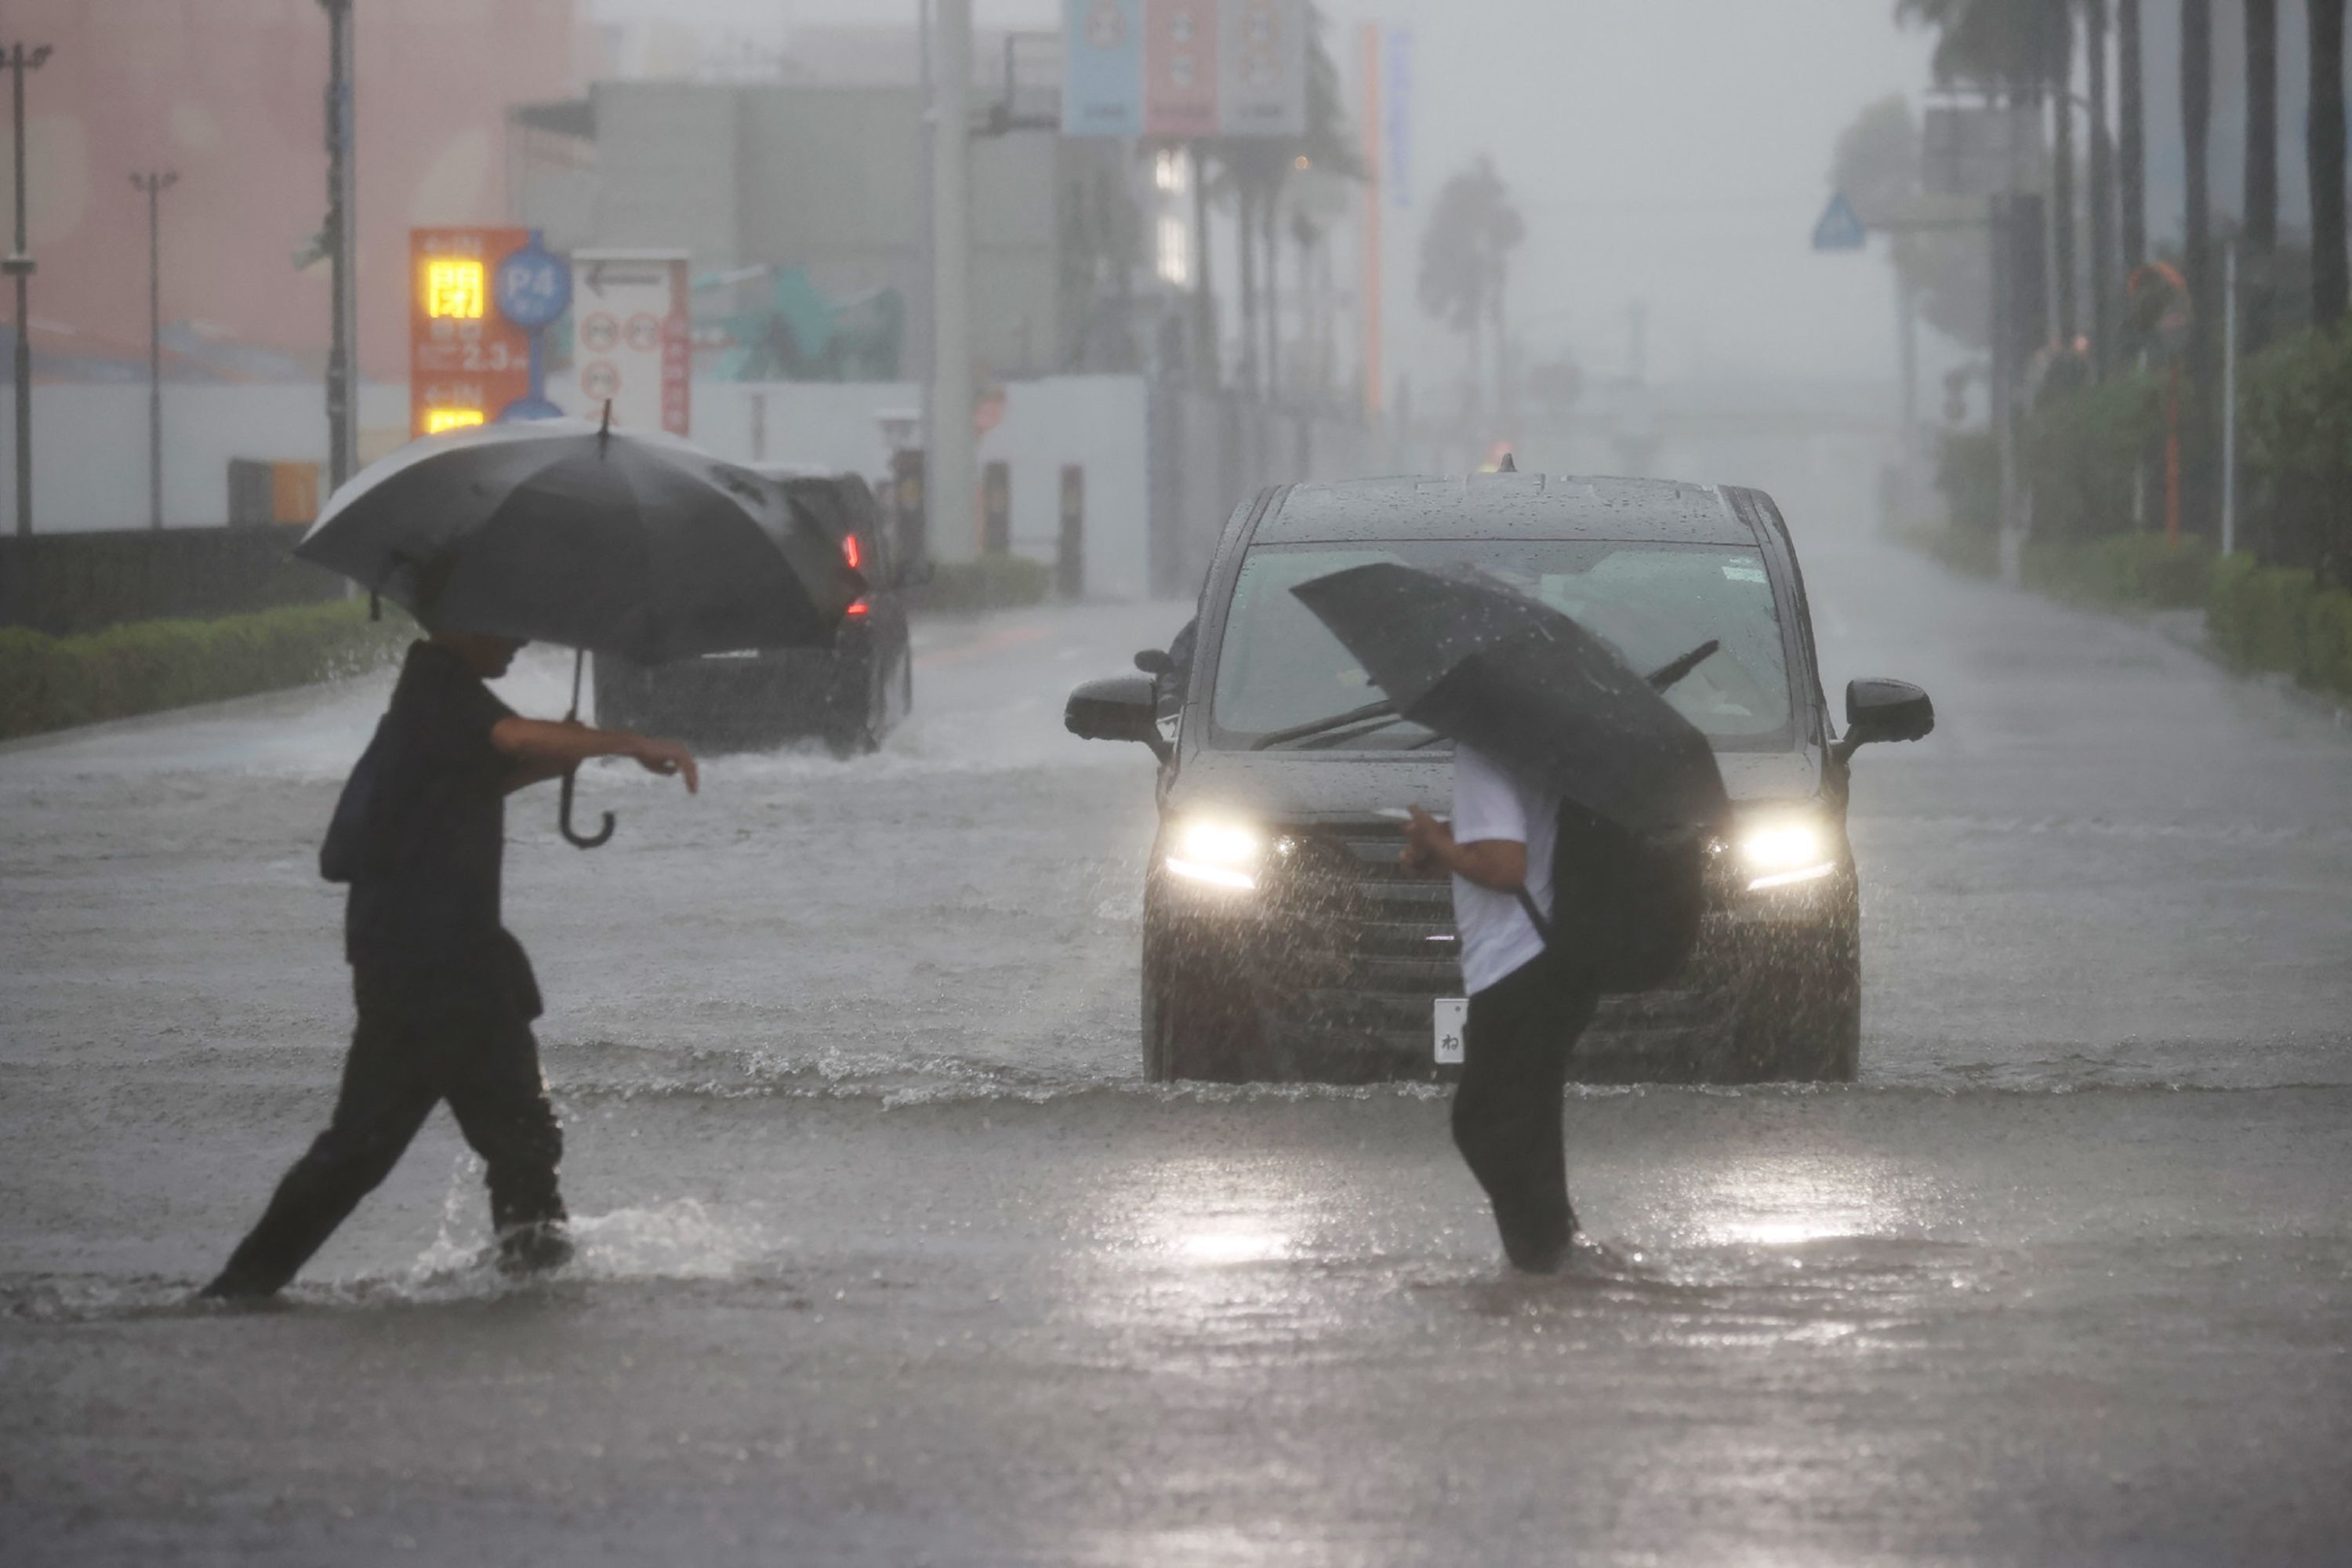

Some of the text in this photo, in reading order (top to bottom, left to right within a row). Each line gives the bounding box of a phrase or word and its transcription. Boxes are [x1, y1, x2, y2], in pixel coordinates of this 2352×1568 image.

[430, 262, 483, 318] 閉
[506, 265, 557, 299] P4
[1441, 1033, 1459, 1051] ね
